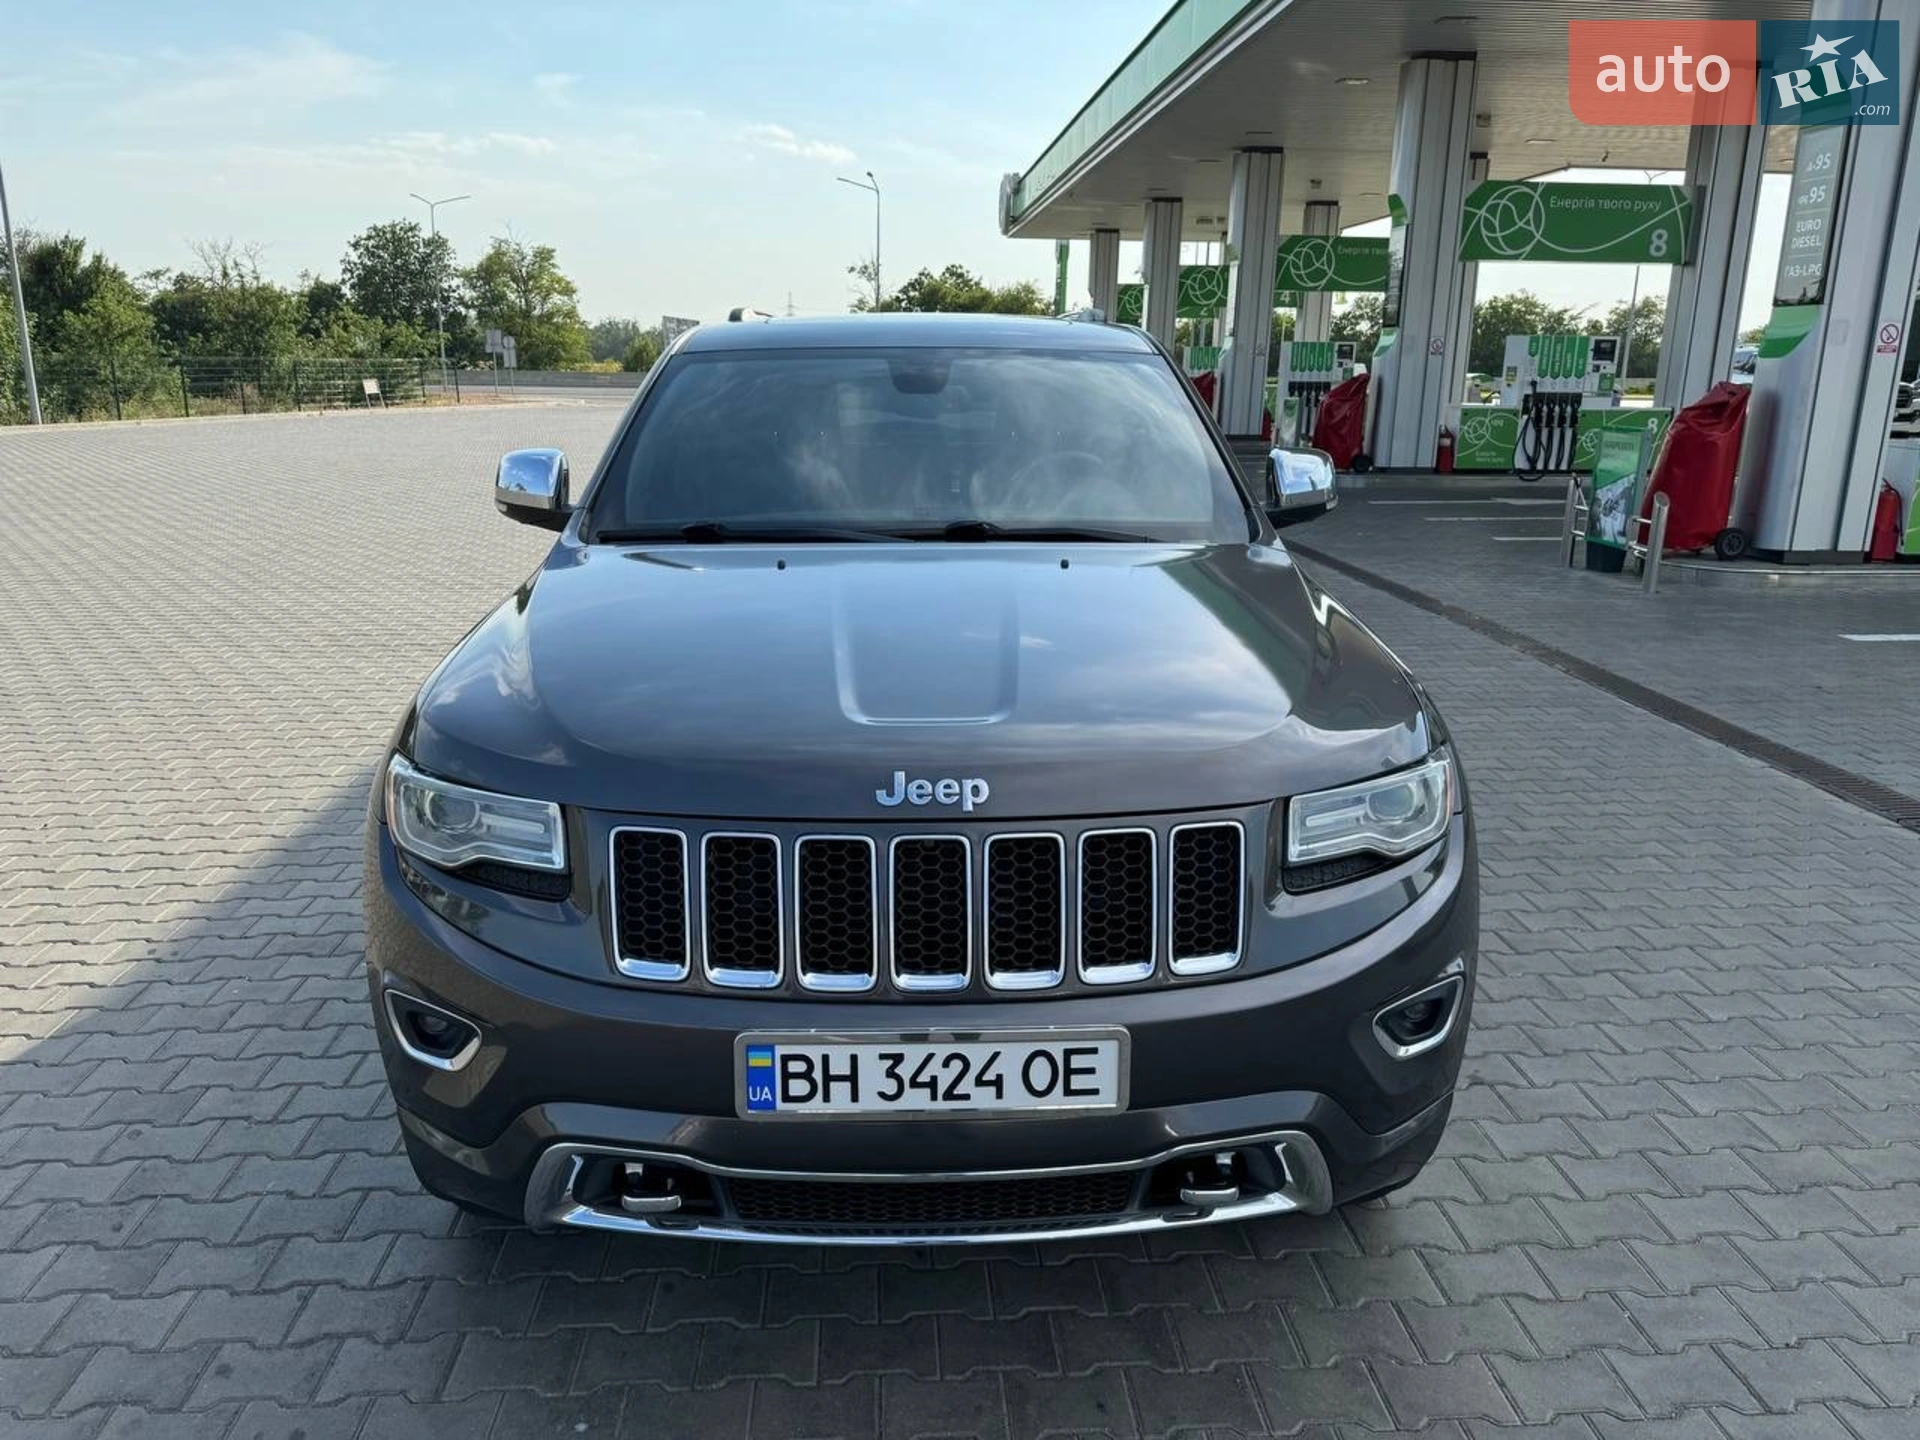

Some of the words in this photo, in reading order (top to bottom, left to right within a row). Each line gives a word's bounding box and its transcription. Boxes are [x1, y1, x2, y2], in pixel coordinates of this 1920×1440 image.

[1550, 196, 1595, 209] Енергія
[1598, 199, 1632, 210] твого
[1634, 200, 1662, 213] руху
[1796, 218, 1822, 233] EURO
[1649, 228, 1669, 258] 8
[1791, 235, 1822, 249] DIESEL
[876, 771, 989, 812] Jeep
[780, 1053, 859, 1104] BH
[877, 1050, 1004, 1102] 3424
[1021, 1046, 1100, 1099] OE
[749, 1086, 773, 1102] UA
